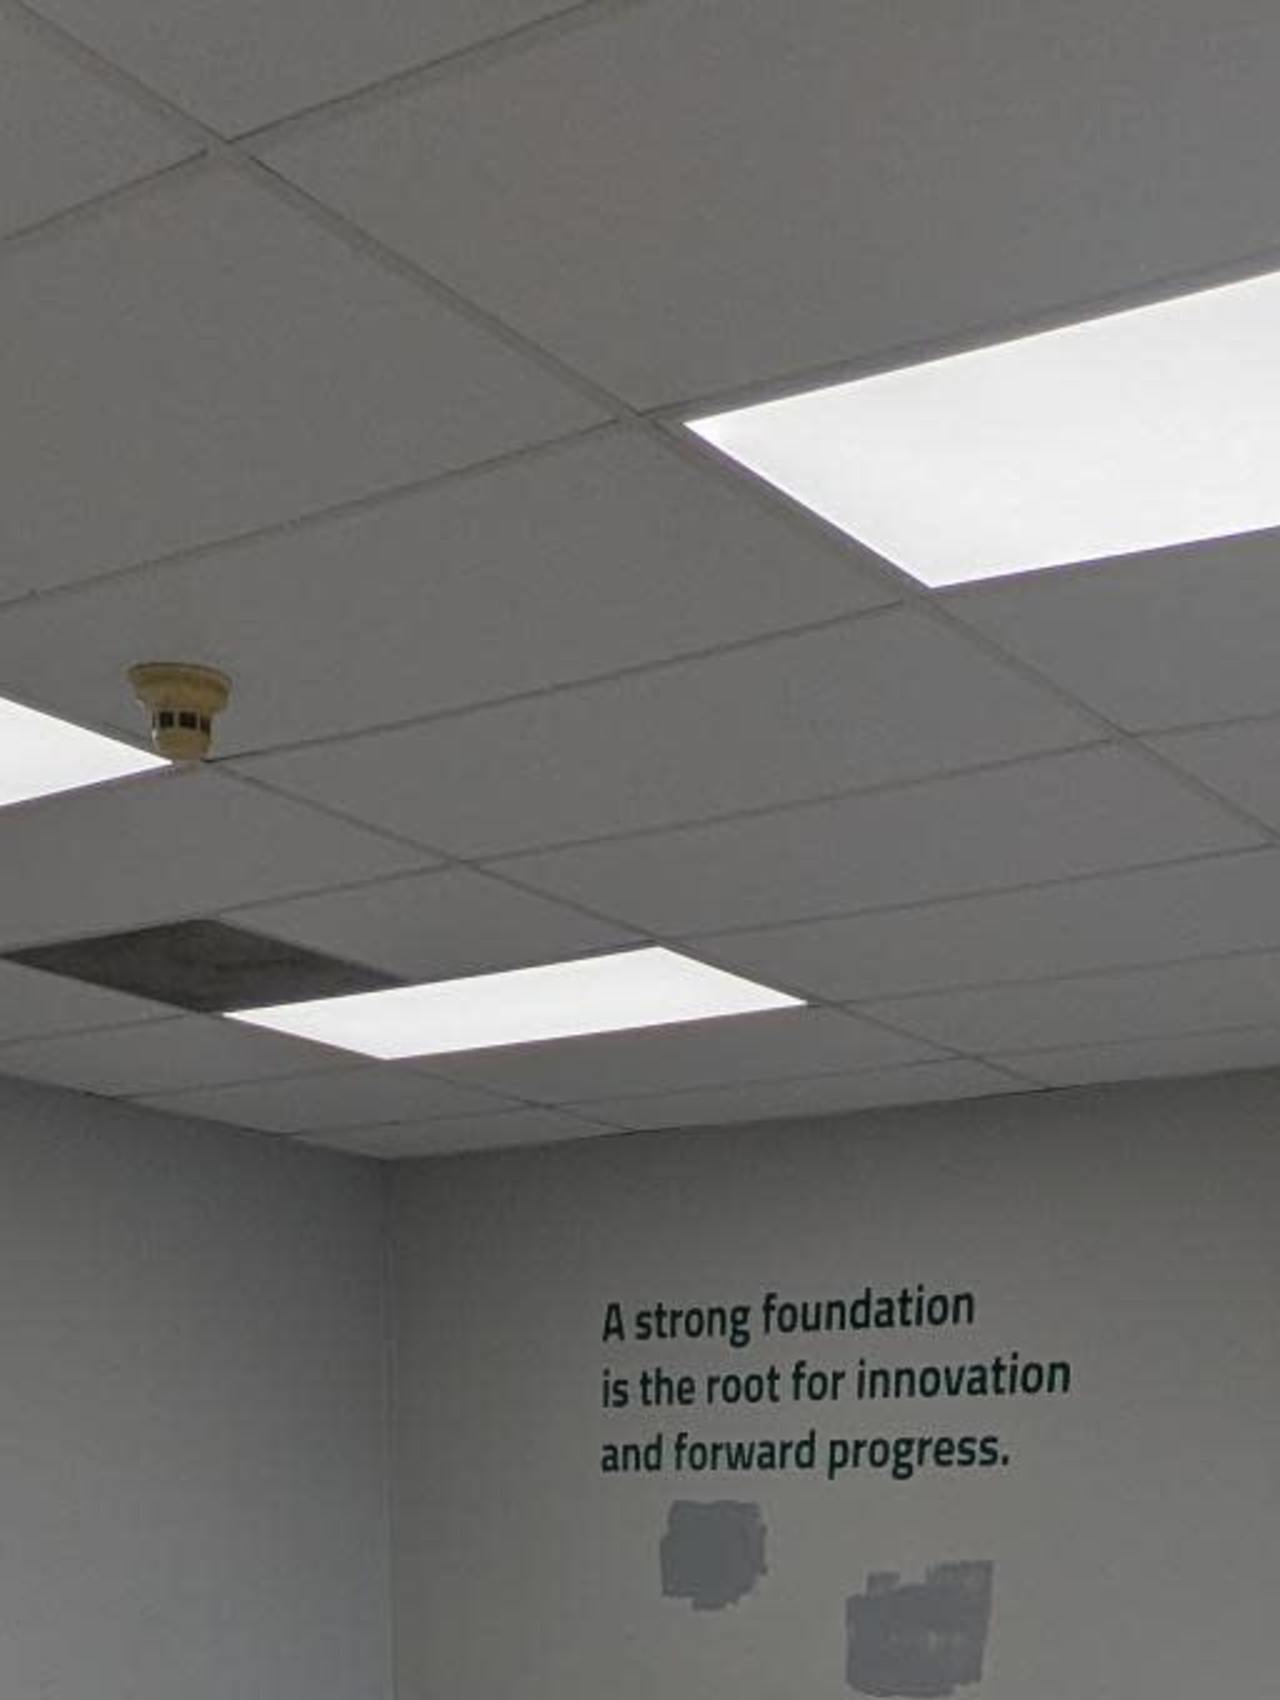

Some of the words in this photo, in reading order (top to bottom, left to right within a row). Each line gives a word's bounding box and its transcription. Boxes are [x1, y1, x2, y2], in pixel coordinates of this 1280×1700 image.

[602, 1303, 625, 1342] A
[634, 1305, 751, 1348] strong
[762, 1285, 975, 1335] foundation
[601, 1368, 629, 1408] is
[639, 1367, 696, 1406] the
[706, 1364, 781, 1403] root
[792, 1360, 846, 1401] for
[856, 1351, 1072, 1400] innovation
[601, 1433, 663, 1472] and
[674, 1430, 816, 1471] forward
[827, 1433, 1011, 1481] progress.
